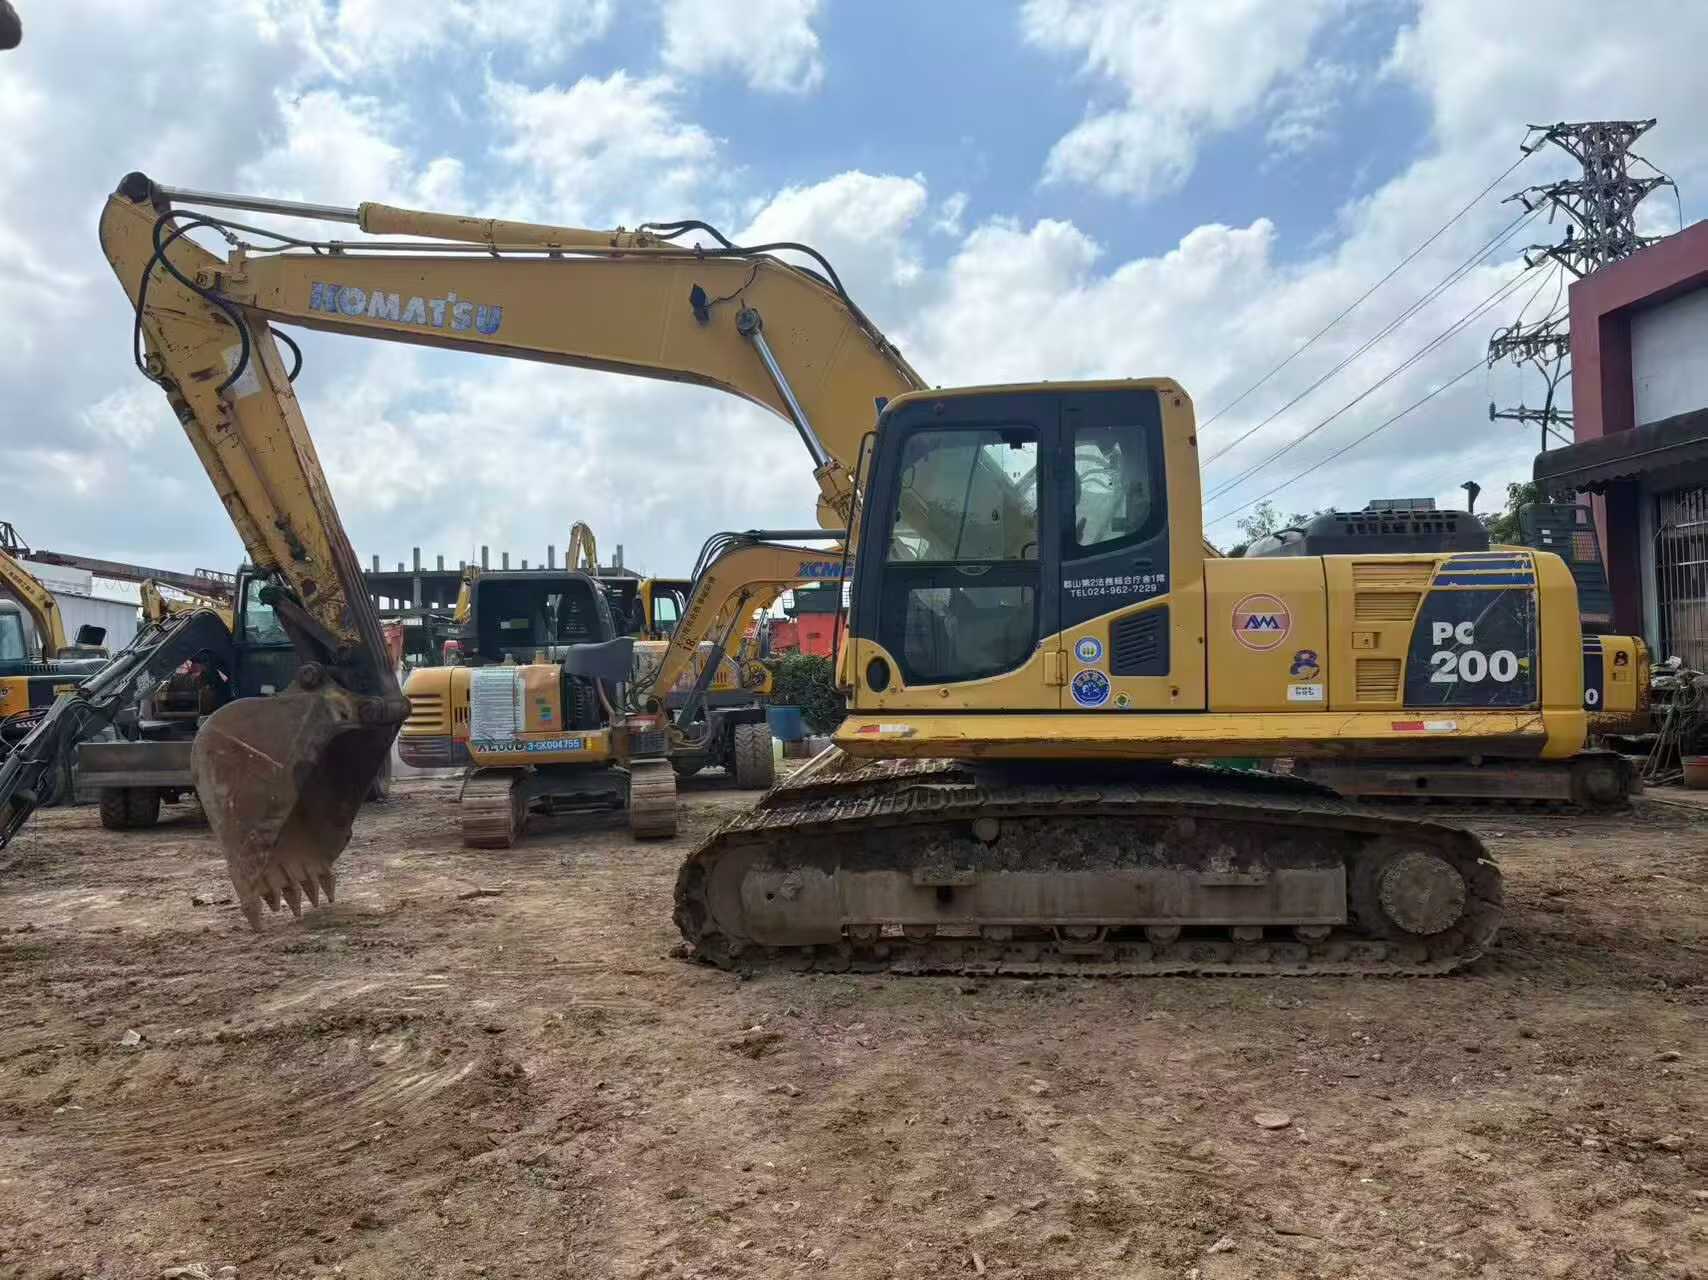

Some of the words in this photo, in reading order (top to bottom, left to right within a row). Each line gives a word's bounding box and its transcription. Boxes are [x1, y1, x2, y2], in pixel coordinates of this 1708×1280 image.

[310, 281, 505, 335] KOMATSU
[1432, 621, 1474, 645] PC
[1429, 650, 1519, 683] 200
